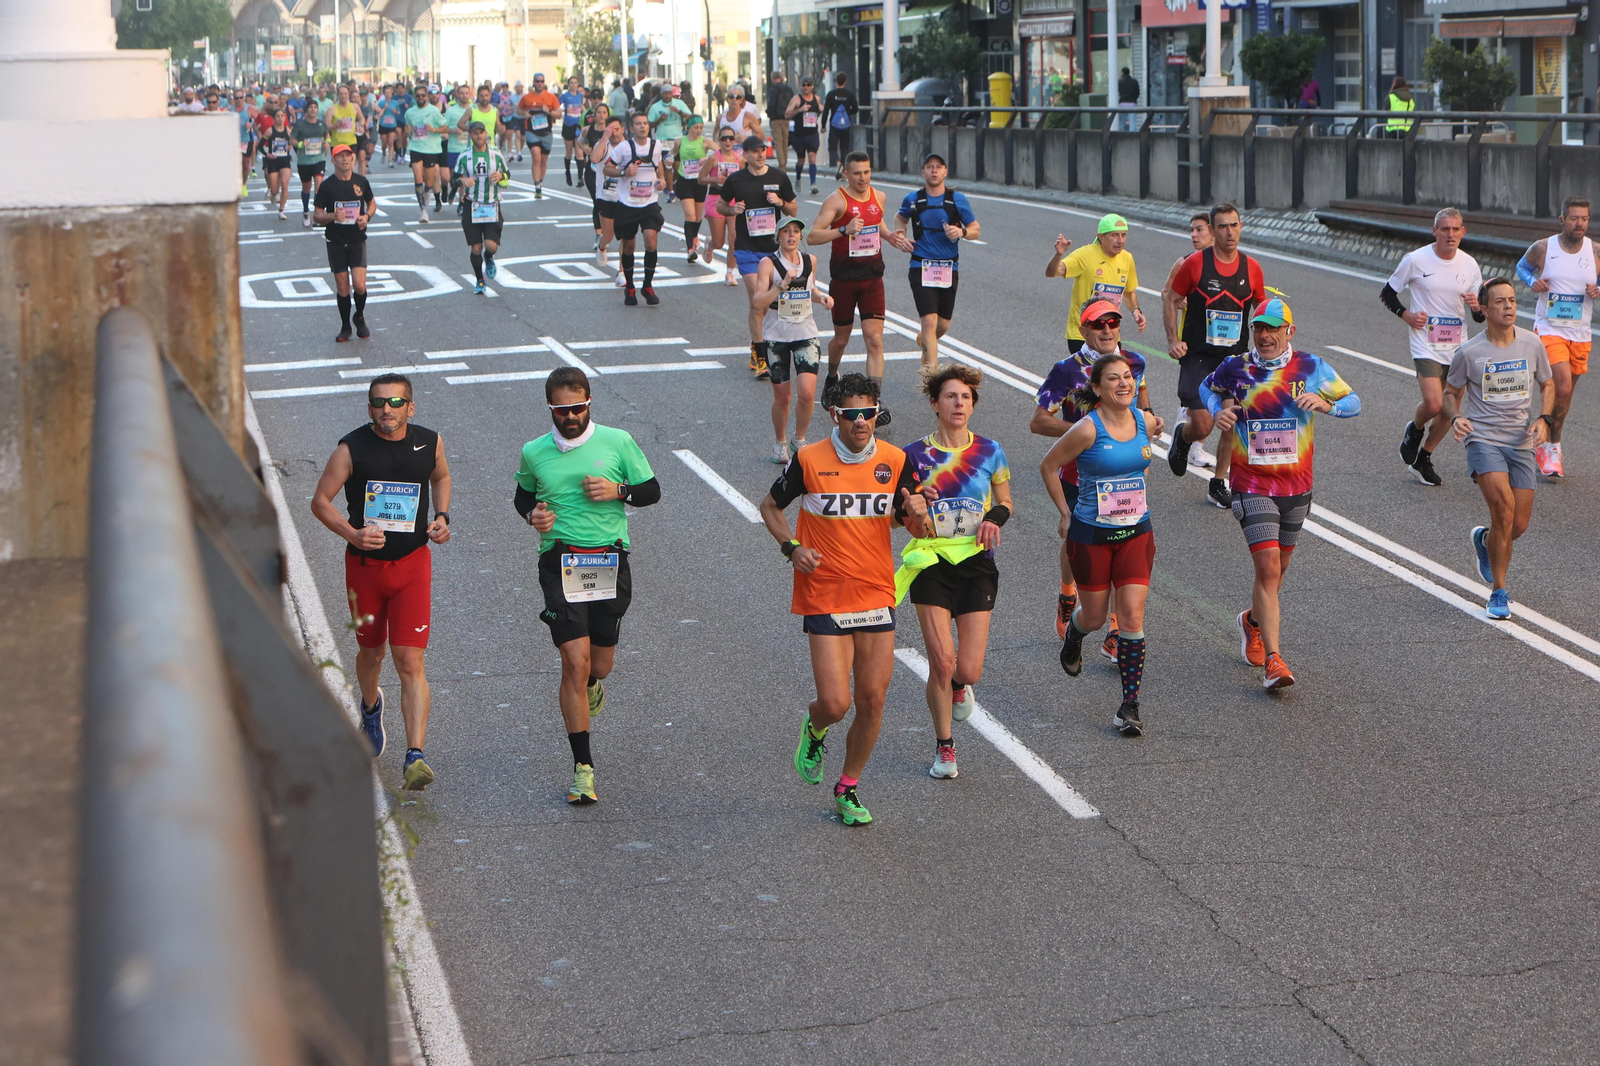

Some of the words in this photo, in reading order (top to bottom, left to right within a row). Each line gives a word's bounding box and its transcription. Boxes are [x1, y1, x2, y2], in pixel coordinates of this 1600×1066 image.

[476, 162, 487, 174] fi
[820, 494, 888, 515] ZPTG
[952, 500, 977, 510] ZURICH
[853, 616, 884, 624] NON-STOP
